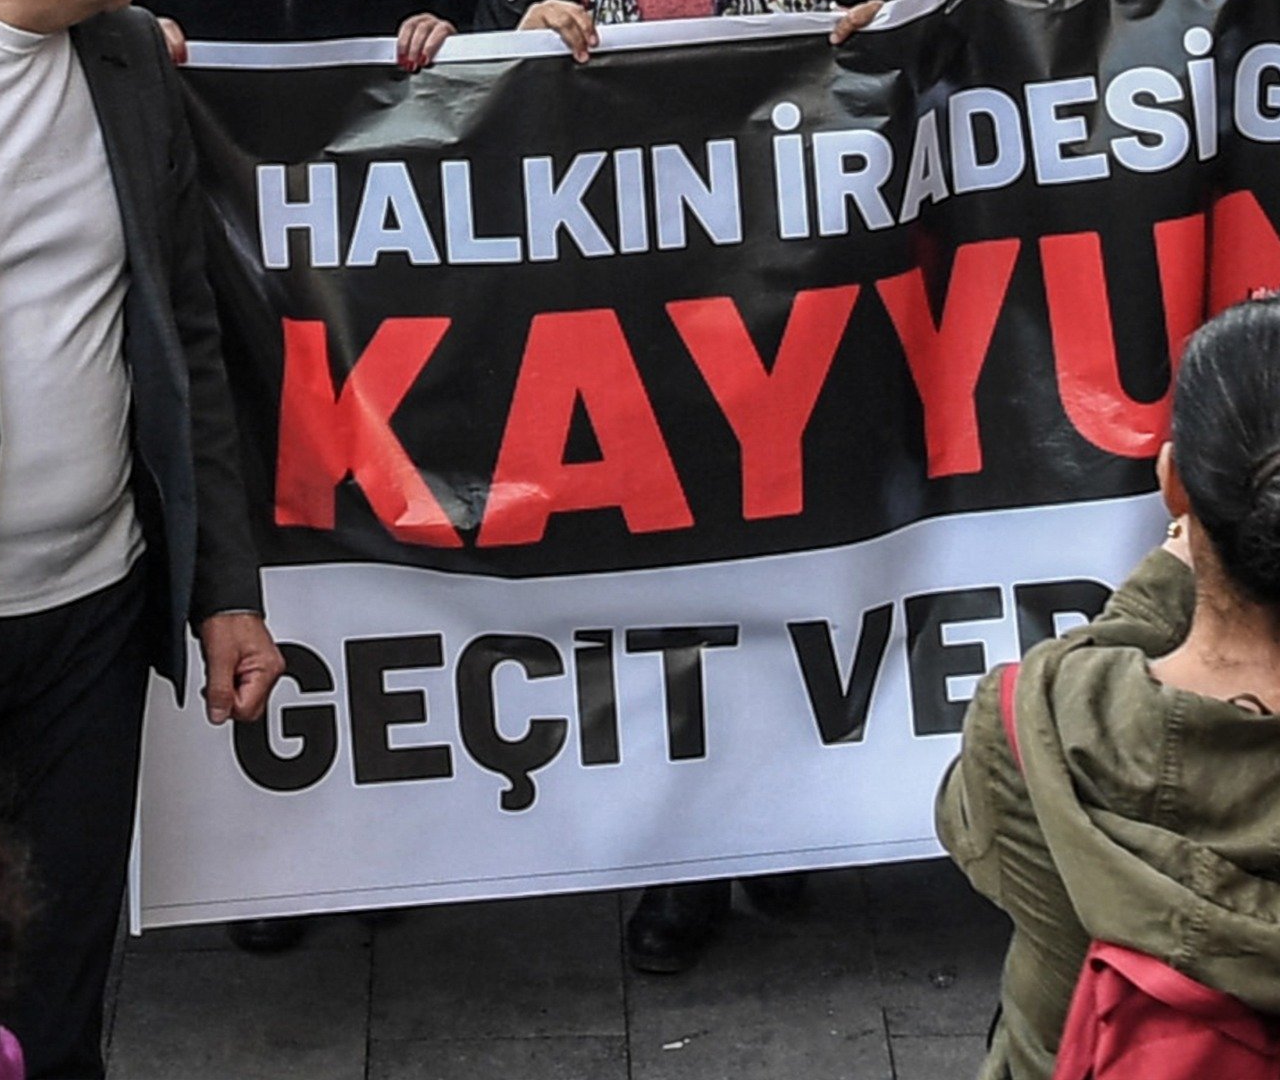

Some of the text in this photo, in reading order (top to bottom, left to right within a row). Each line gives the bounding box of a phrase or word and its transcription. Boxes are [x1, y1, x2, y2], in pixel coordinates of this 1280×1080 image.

[256, 138, 742, 269] HALKIN
[771, 26, 1218, 240] İRADESİ
[233, 624, 740, 812] GEÇİT
